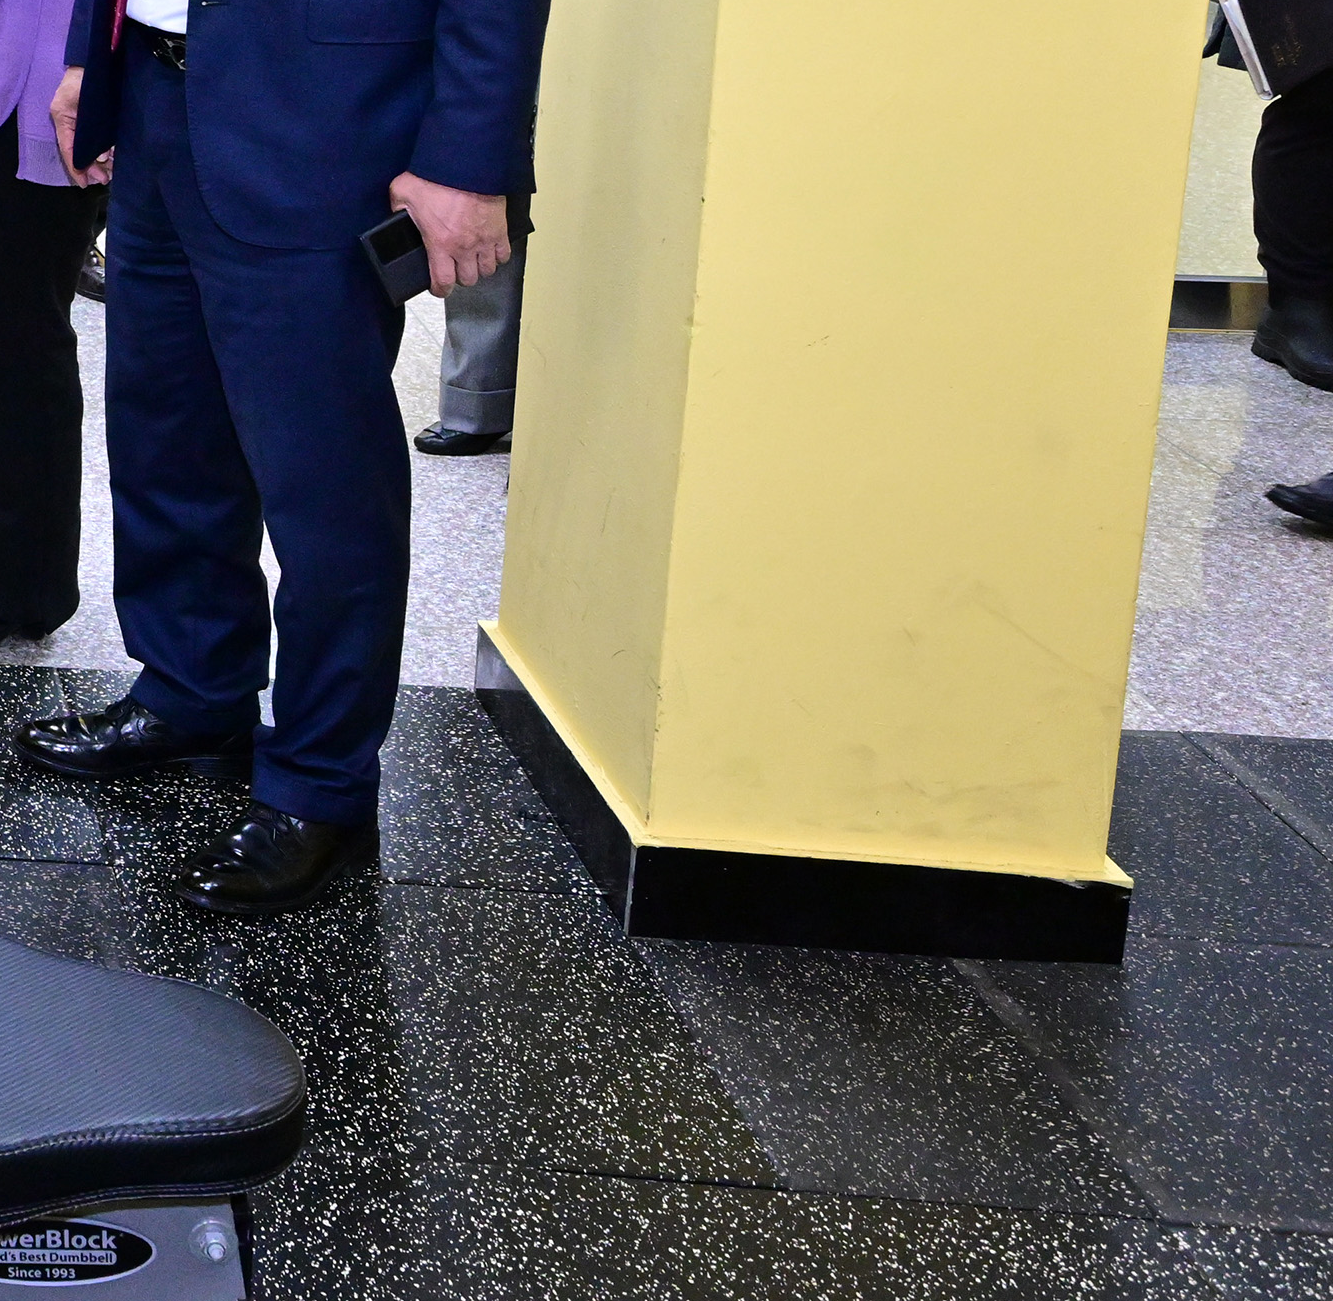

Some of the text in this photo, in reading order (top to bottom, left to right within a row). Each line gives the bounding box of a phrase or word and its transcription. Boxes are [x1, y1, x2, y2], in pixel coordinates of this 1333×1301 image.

[19, 1251, 46, 1261] Best
[50, 1252, 113, 1263] Dumbbell
[8, 1267, 76, 1279] Since 1993
